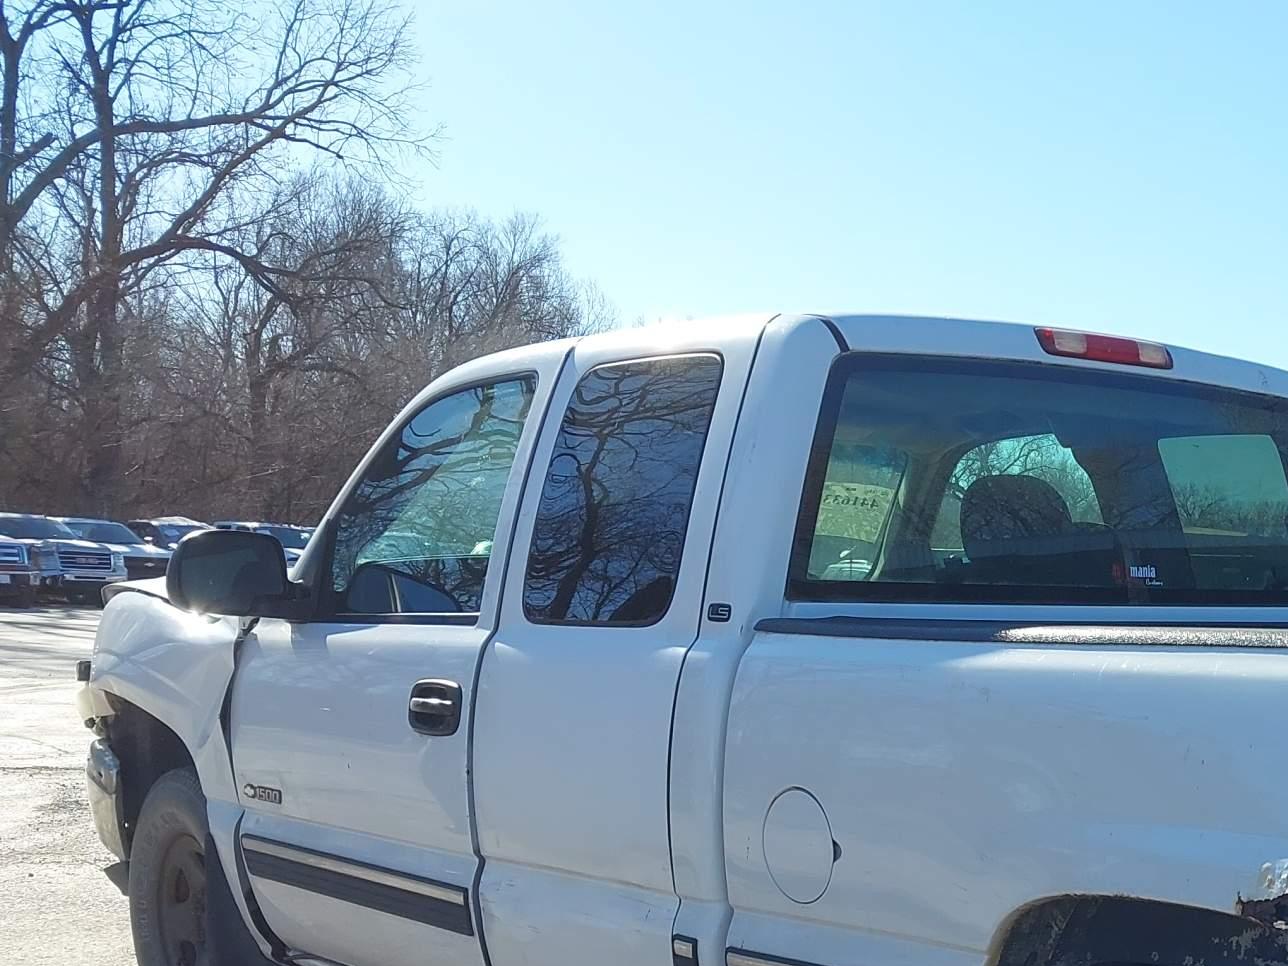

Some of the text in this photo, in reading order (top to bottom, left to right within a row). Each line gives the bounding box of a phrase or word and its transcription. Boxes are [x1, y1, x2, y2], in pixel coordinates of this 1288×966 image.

[1130, 564, 1156, 578] mania
[710, 606, 729, 618] LS
[256, 787, 280, 802] 1500
